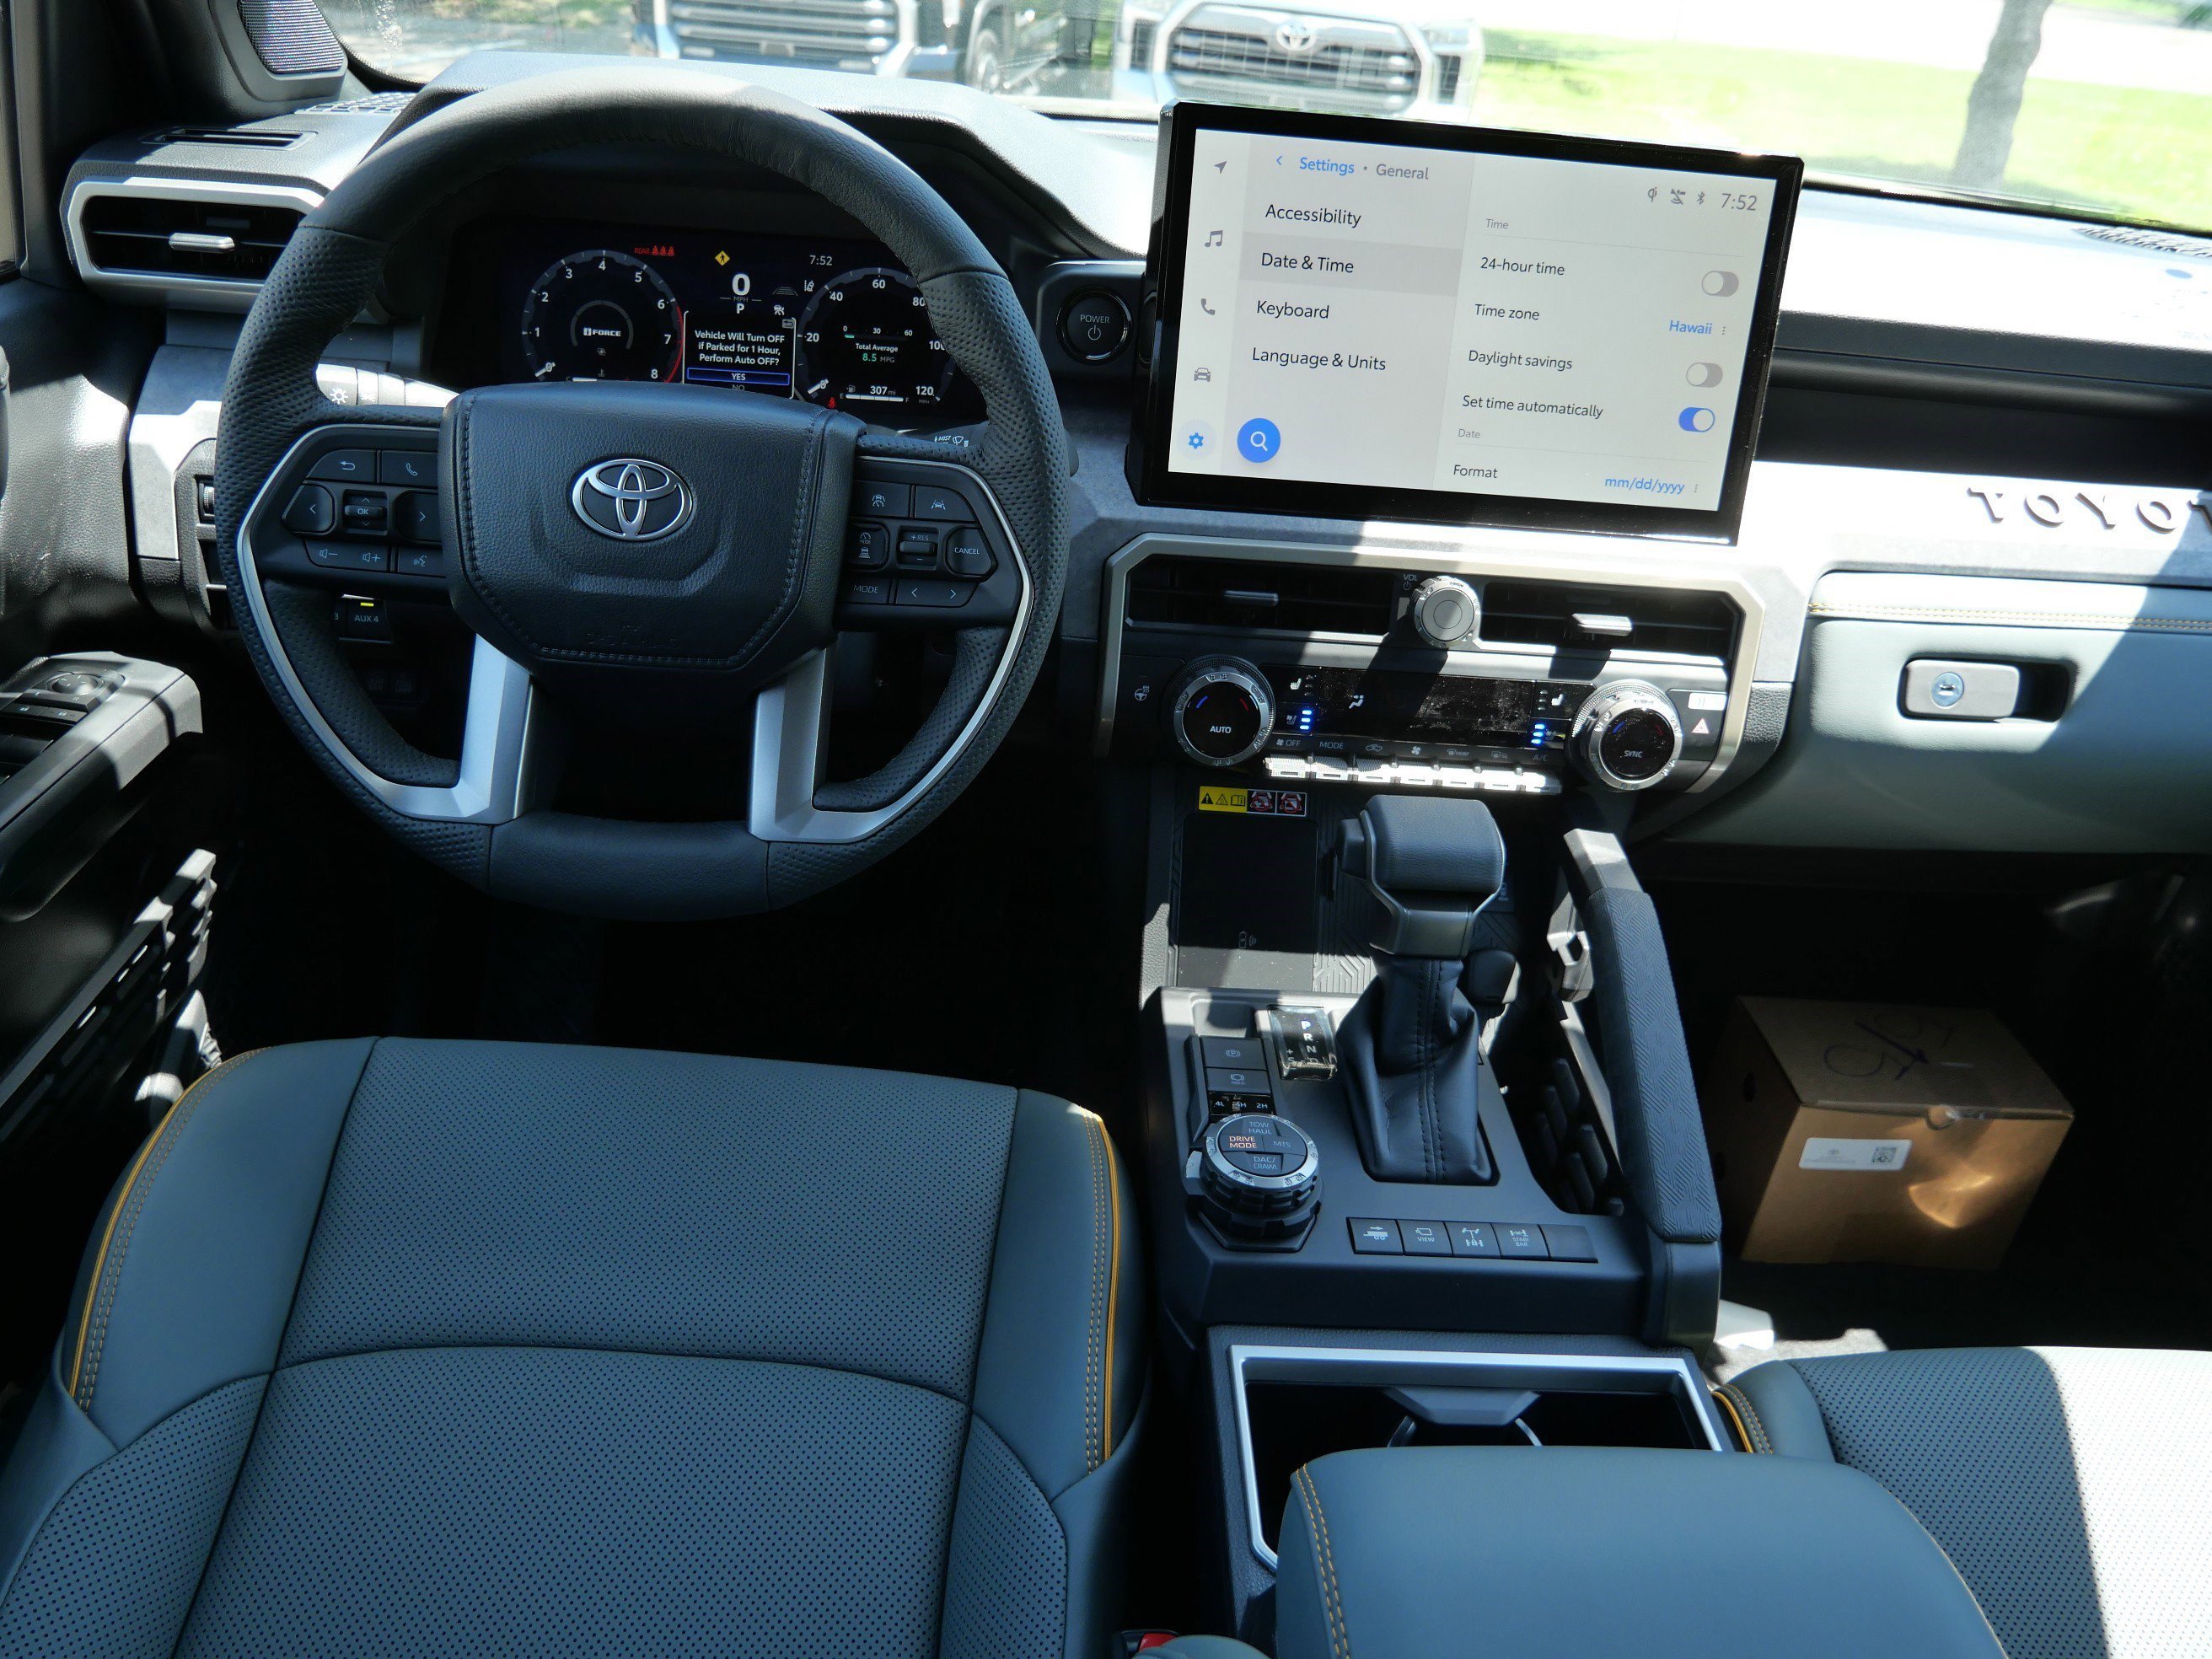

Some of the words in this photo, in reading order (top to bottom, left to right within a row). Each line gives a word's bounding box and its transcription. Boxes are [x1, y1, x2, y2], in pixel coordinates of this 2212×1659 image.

[1299, 156, 1355, 176] Settings
[1376, 163, 1429, 180] General
[1721, 192, 1758, 212] 7:52
[1264, 204, 1362, 229] Accessibility
[1485, 218, 1509, 229] Time
[599, 260, 606, 271] 4
[809, 255, 833, 266] 7:52
[1261, 252, 1297, 269] Date
[1301, 255, 1313, 270] &
[1317, 257, 1354, 273] Time
[1480, 257, 1533, 273] 24-hour
[1535, 261, 1565, 276] time
[566, 268, 573, 279] 3
[635, 272, 642, 282] 5
[732, 272, 751, 296] 0
[872, 280, 886, 289] 60
[541, 292, 549, 303] 2
[830, 292, 844, 302] 40
[657, 299, 665, 309] 6
[736, 303, 745, 314] P
[1256, 300, 1329, 319] Keyboard
[1474, 303, 1505, 318] Time
[1508, 309, 1540, 320] zone
[1080, 314, 1110, 324] POWER
[534, 327, 540, 337] 1
[1668, 319, 1713, 335] Hawaii
[664, 334, 672, 345] 7
[695, 330, 726, 340] Vehicle
[727, 332, 744, 341] Will
[747, 333, 766, 342] Turn
[767, 335, 785, 343] OFF
[806, 333, 819, 342] 20
[698, 341, 705, 350] if
[706, 342, 735, 352] Parked
[737, 343, 749, 352] for
[751, 345, 755, 353] 1
[758, 346, 781, 356] Hour,
[872, 344, 899, 352] Average
[700, 353, 733, 363] Perform
[734, 355, 755, 364] Auto
[758, 357, 780, 366] OFF?
[862, 353, 878, 362] 8.5
[1252, 348, 1329, 369] Language
[1332, 352, 1344, 368] &
[1348, 354, 1386, 371] Units
[1468, 350, 1523, 368] Daylight
[1525, 356, 1573, 372] savings
[651, 368, 658, 379] 8
[732, 373, 746, 381] YES
[870, 386, 888, 395] 307
[915, 386, 934, 396] 120
[1462, 395, 1483, 408] Set
[1485, 398, 1514, 411] time
[1517, 401, 1603, 420] automatically
[1458, 428, 1481, 438] Date
[1453, 464, 1498, 479] Format
[1604, 477, 1685, 495] mm/dd/yyyy
[854, 584, 878, 593] MODE
[1210, 726, 1232, 734] AUTO
[1286, 739, 1301, 748] OFF
[1319, 741, 1344, 749] MODE
[1624, 749, 1643, 759] SYNC
[1301, 1020, 1312, 1030] P
[1303, 1033, 1313, 1041] R
